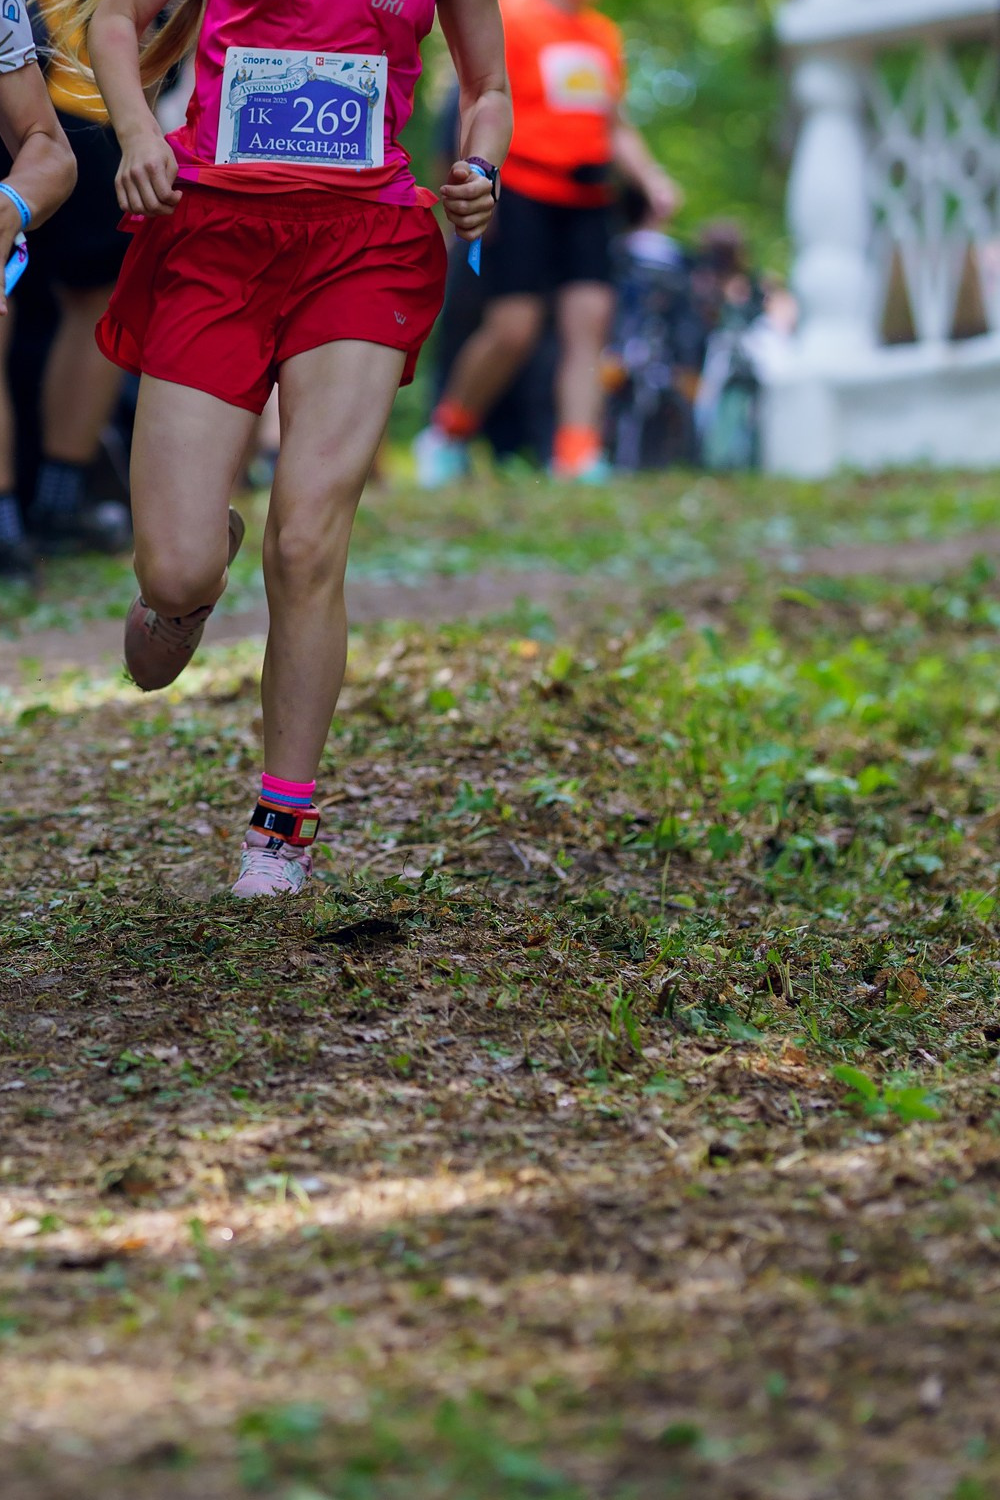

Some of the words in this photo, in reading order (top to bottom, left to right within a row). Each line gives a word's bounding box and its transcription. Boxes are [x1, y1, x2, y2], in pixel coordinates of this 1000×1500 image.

[243, 57, 270, 65] СПОРТ
[272, 58, 283, 66] 40
[239, 78, 301, 96] Лукоморье
[290, 96, 362, 136] 269
[248, 132, 360, 160] Александра
